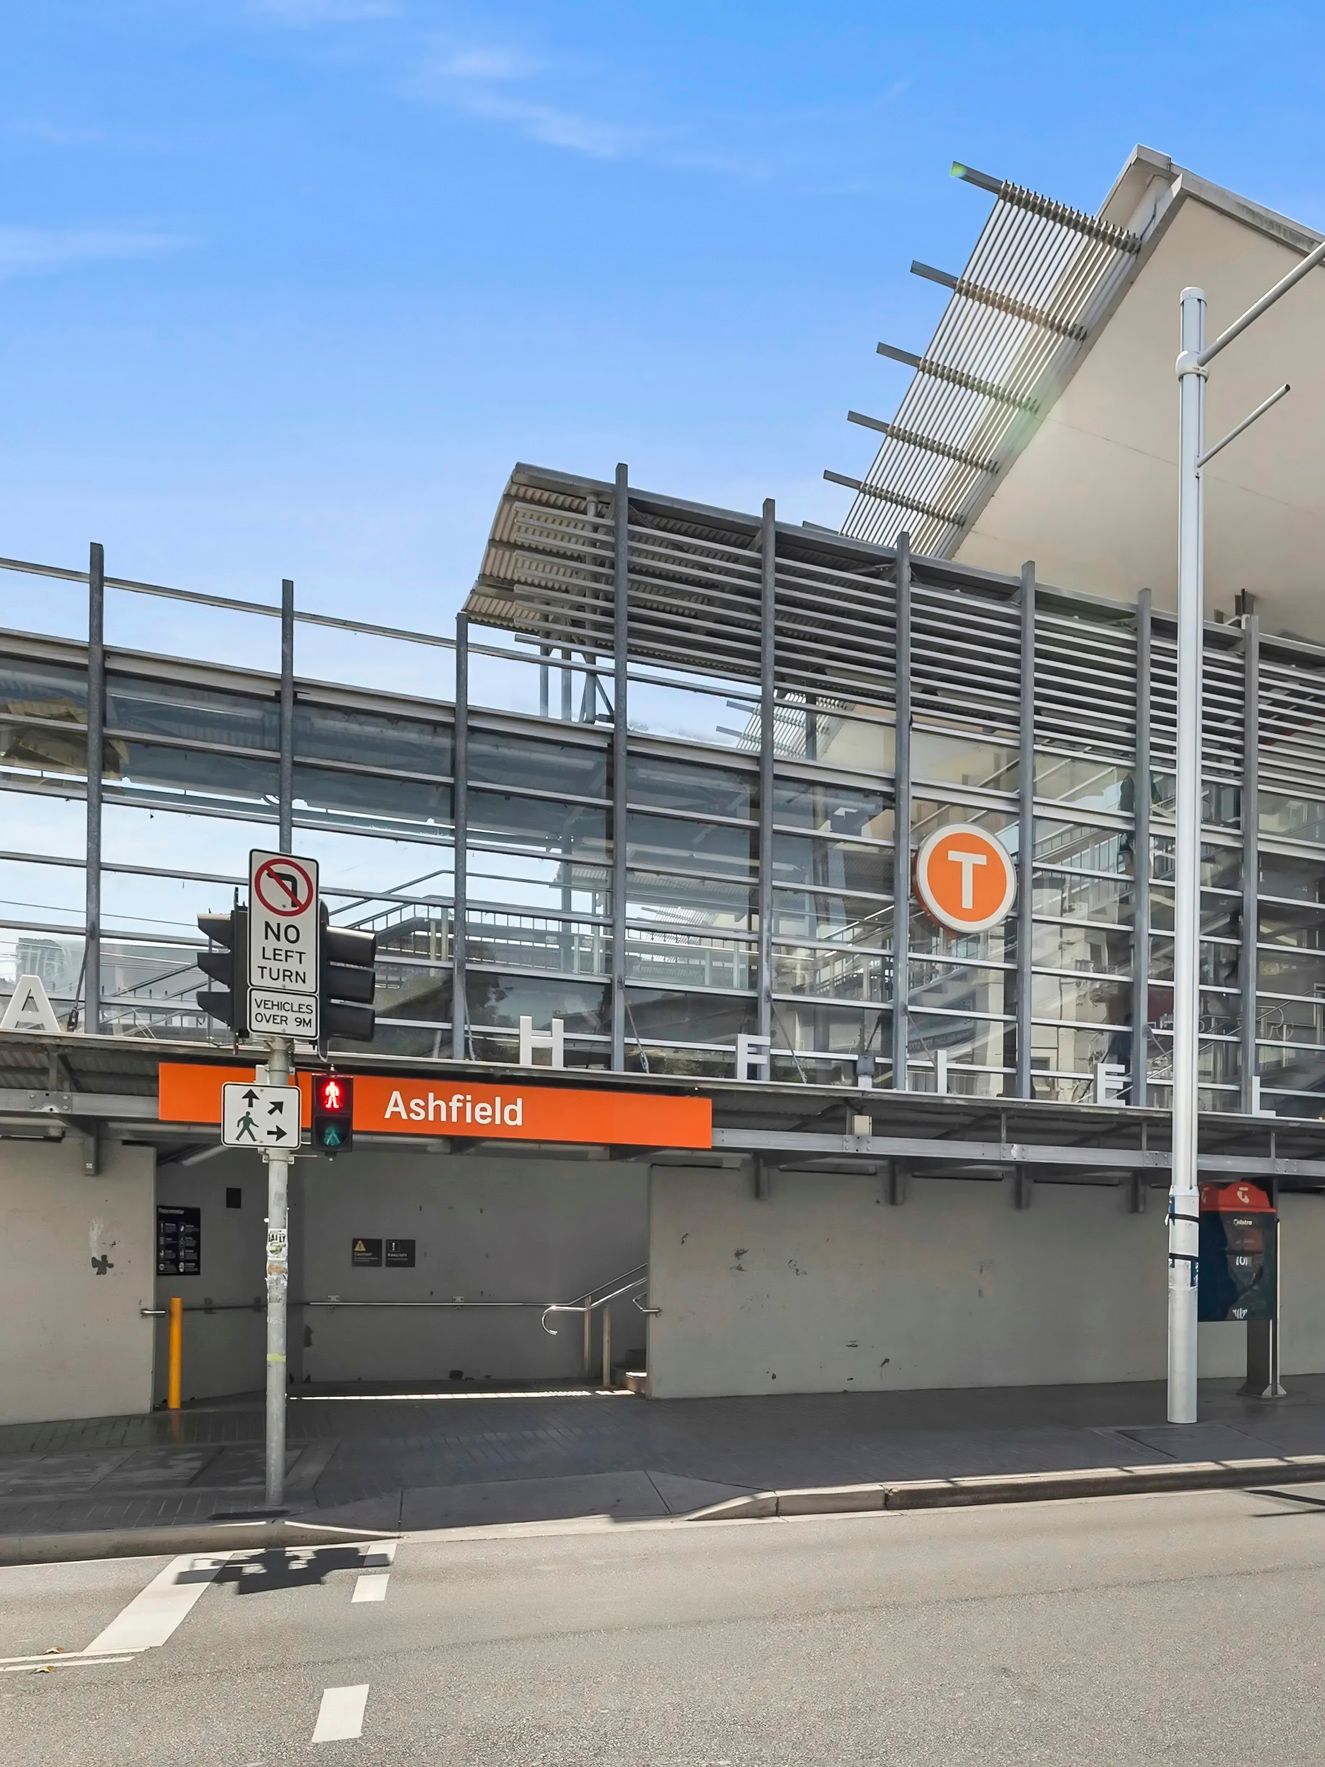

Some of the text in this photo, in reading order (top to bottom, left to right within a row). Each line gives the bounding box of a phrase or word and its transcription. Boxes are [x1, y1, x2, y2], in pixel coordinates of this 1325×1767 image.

[947, 850, 988, 909] T
[264, 920, 300, 944] NO
[262, 946, 306, 964] LEFT
[257, 966, 306, 984] TURN
[254, 998, 313, 1014] VEHICLES
[255, 1012, 312, 1028] OVER 9M
[384, 1090, 523, 1126] Ashfield
